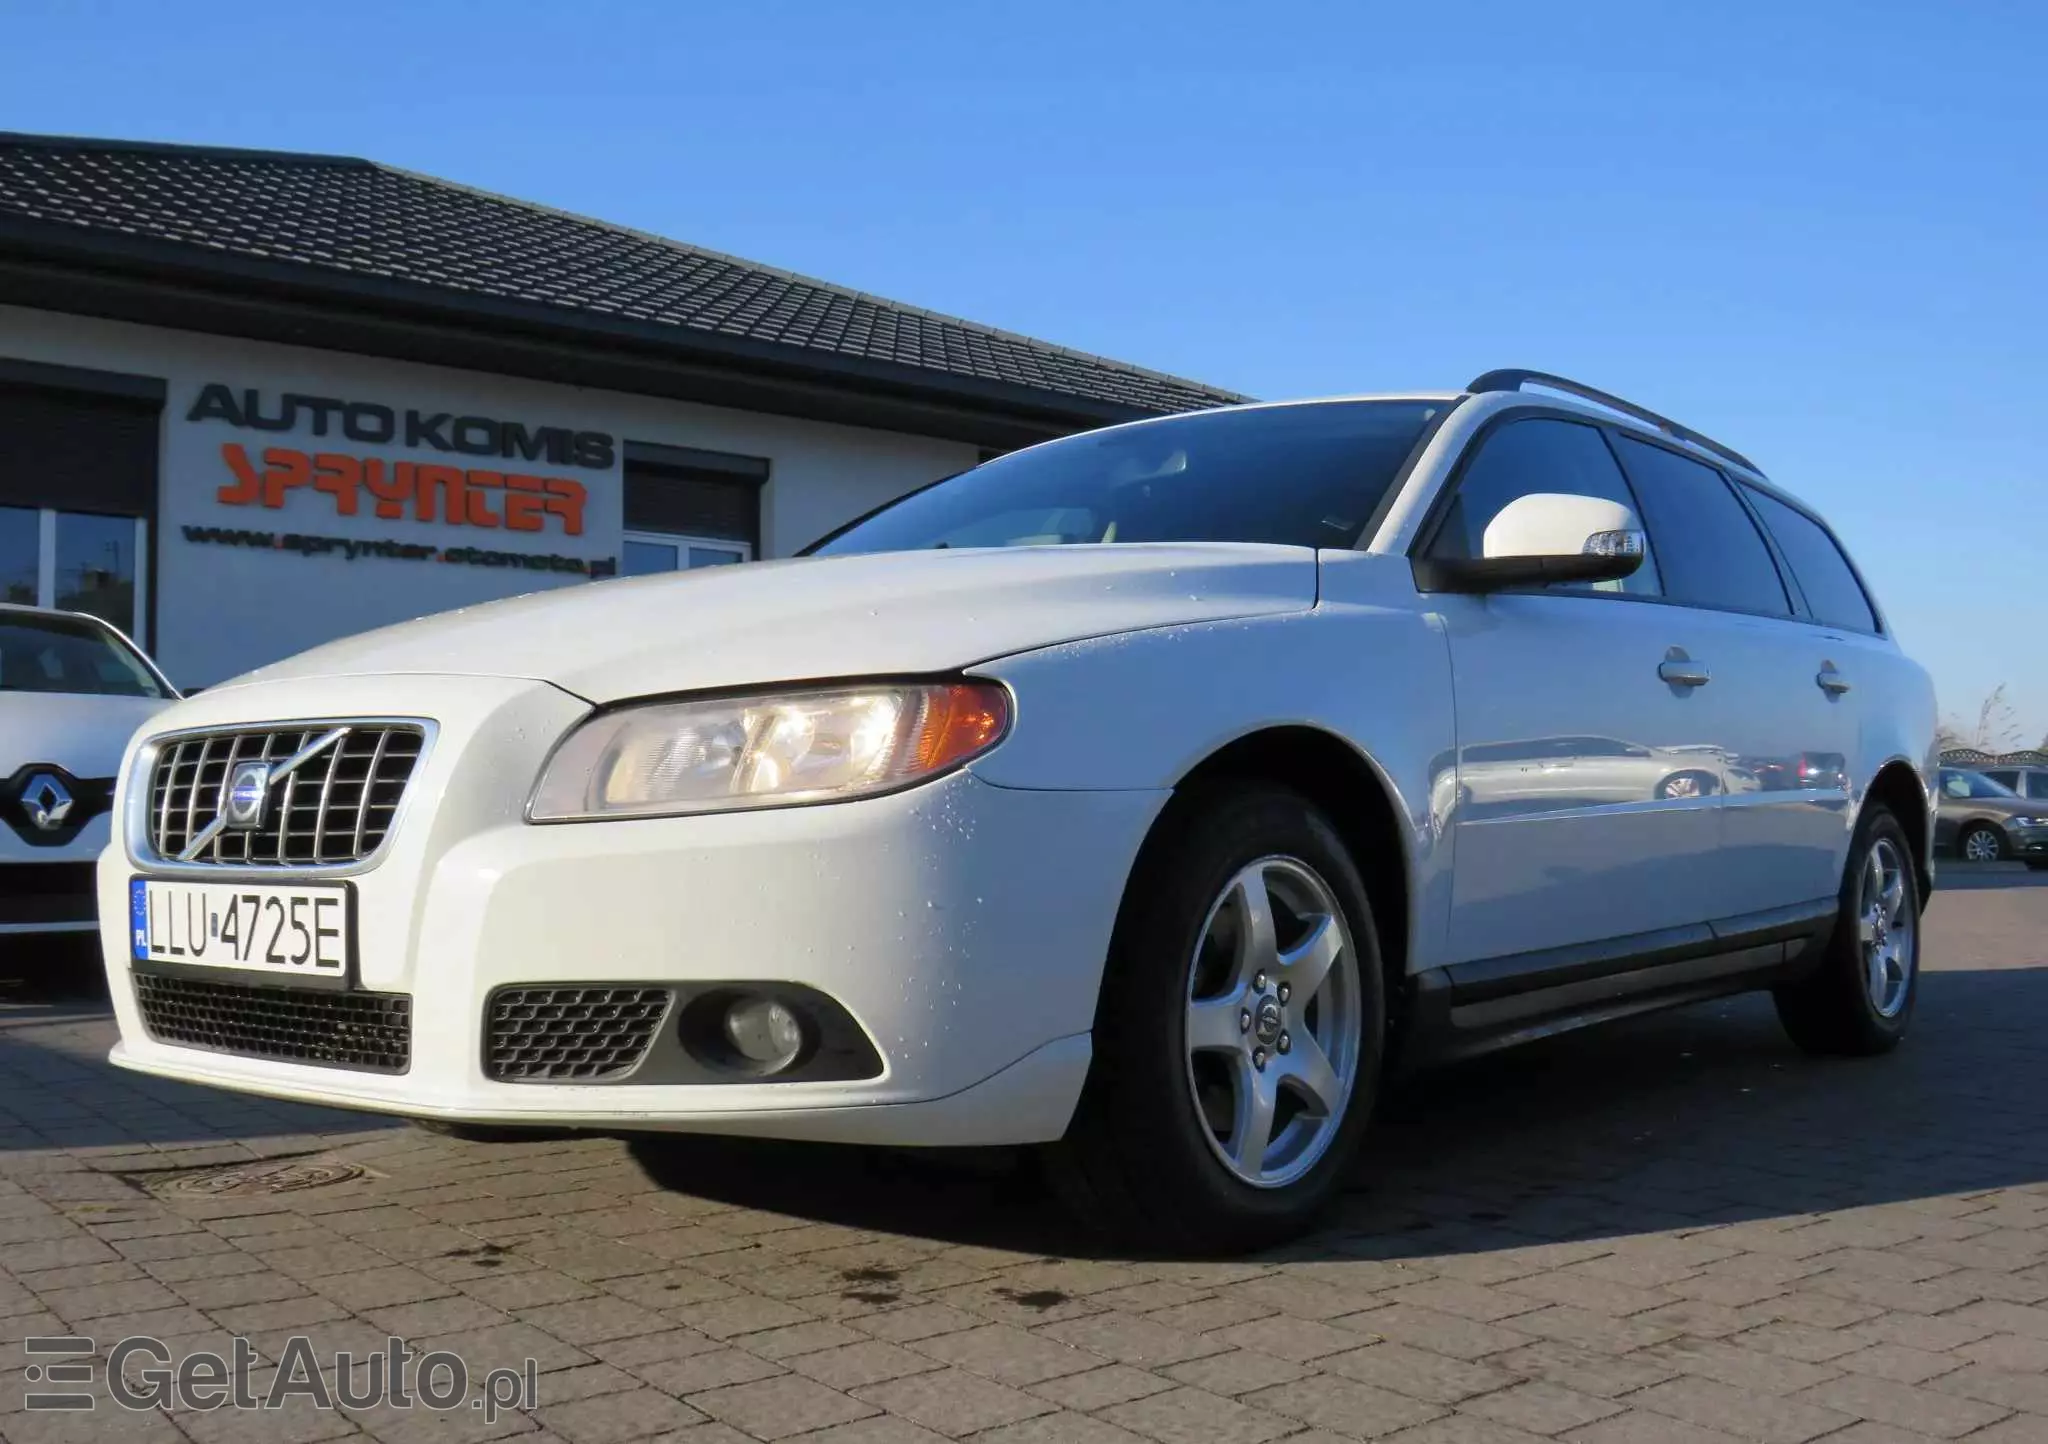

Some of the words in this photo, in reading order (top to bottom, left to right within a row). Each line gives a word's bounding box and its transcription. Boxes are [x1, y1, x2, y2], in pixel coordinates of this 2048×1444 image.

[186, 383, 395, 443] AUTO
[405, 409, 615, 469] KOMIS
[217, 443, 587, 536] SPRYNTER
